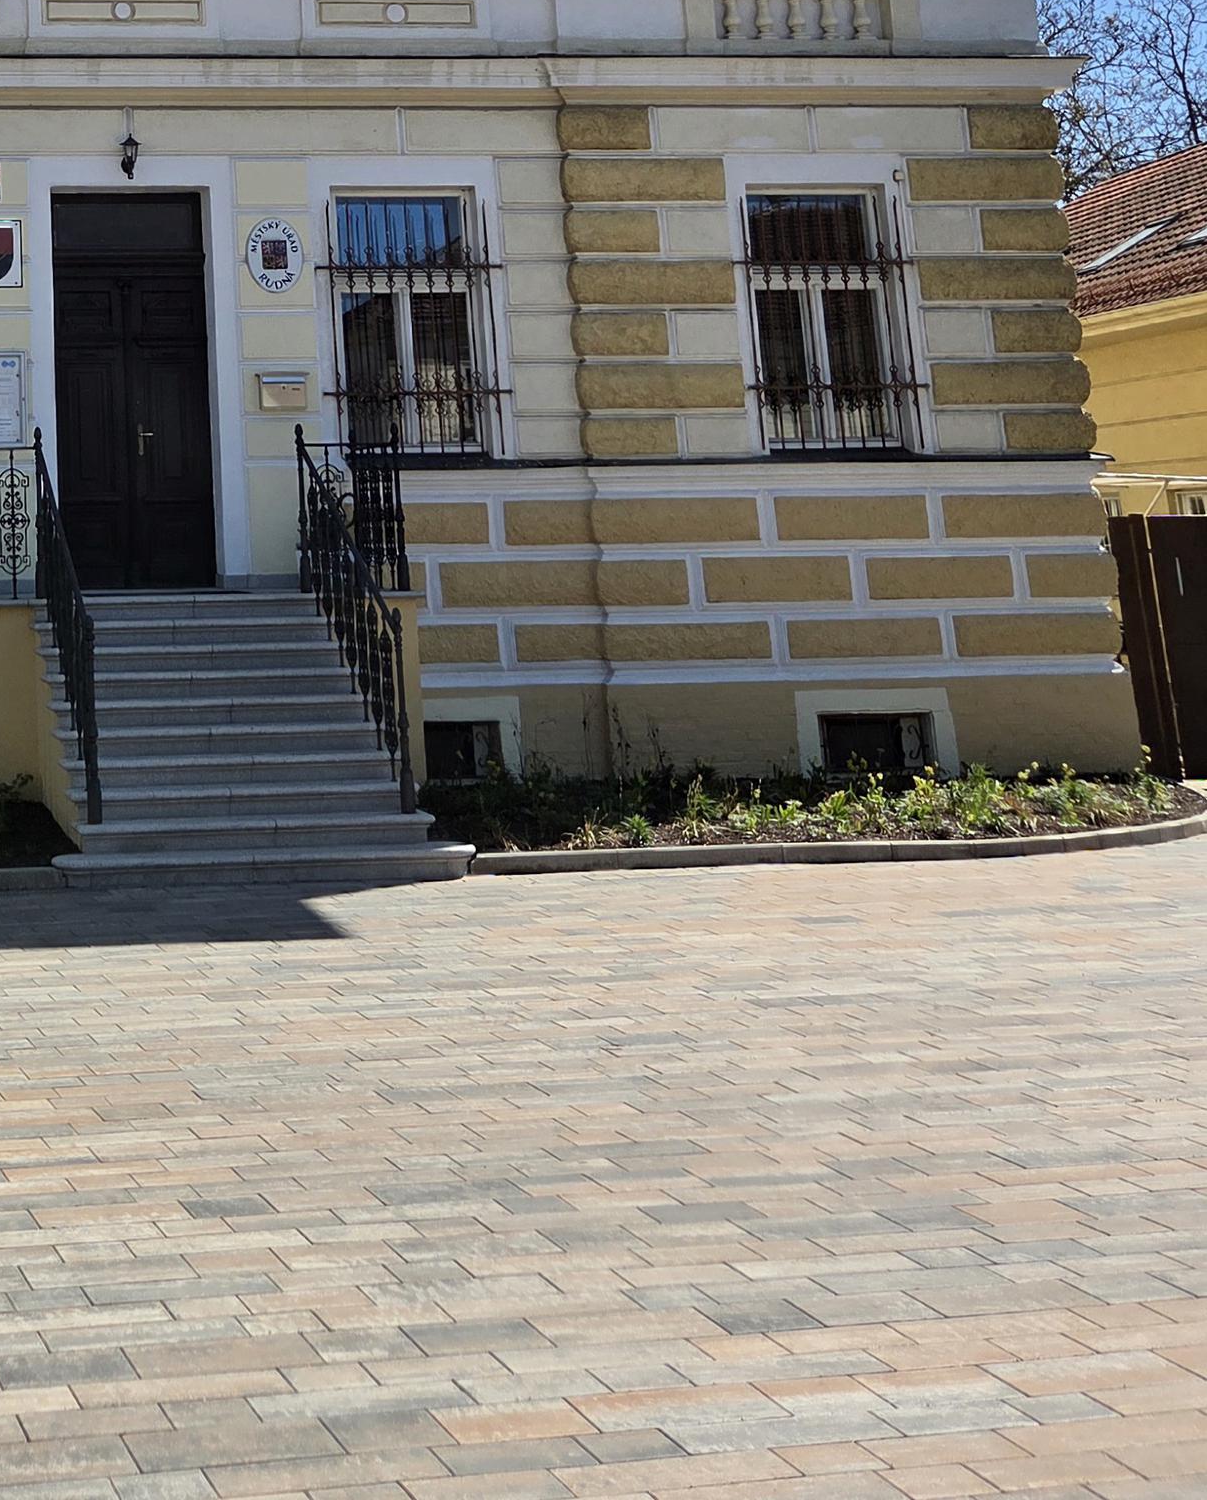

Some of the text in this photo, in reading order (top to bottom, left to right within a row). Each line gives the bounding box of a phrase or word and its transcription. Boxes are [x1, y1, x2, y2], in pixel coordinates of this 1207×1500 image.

[250, 220, 298, 253] MĚSTSKÝ ÚŘAD
[258, 270, 296, 290] RUDNÁ
